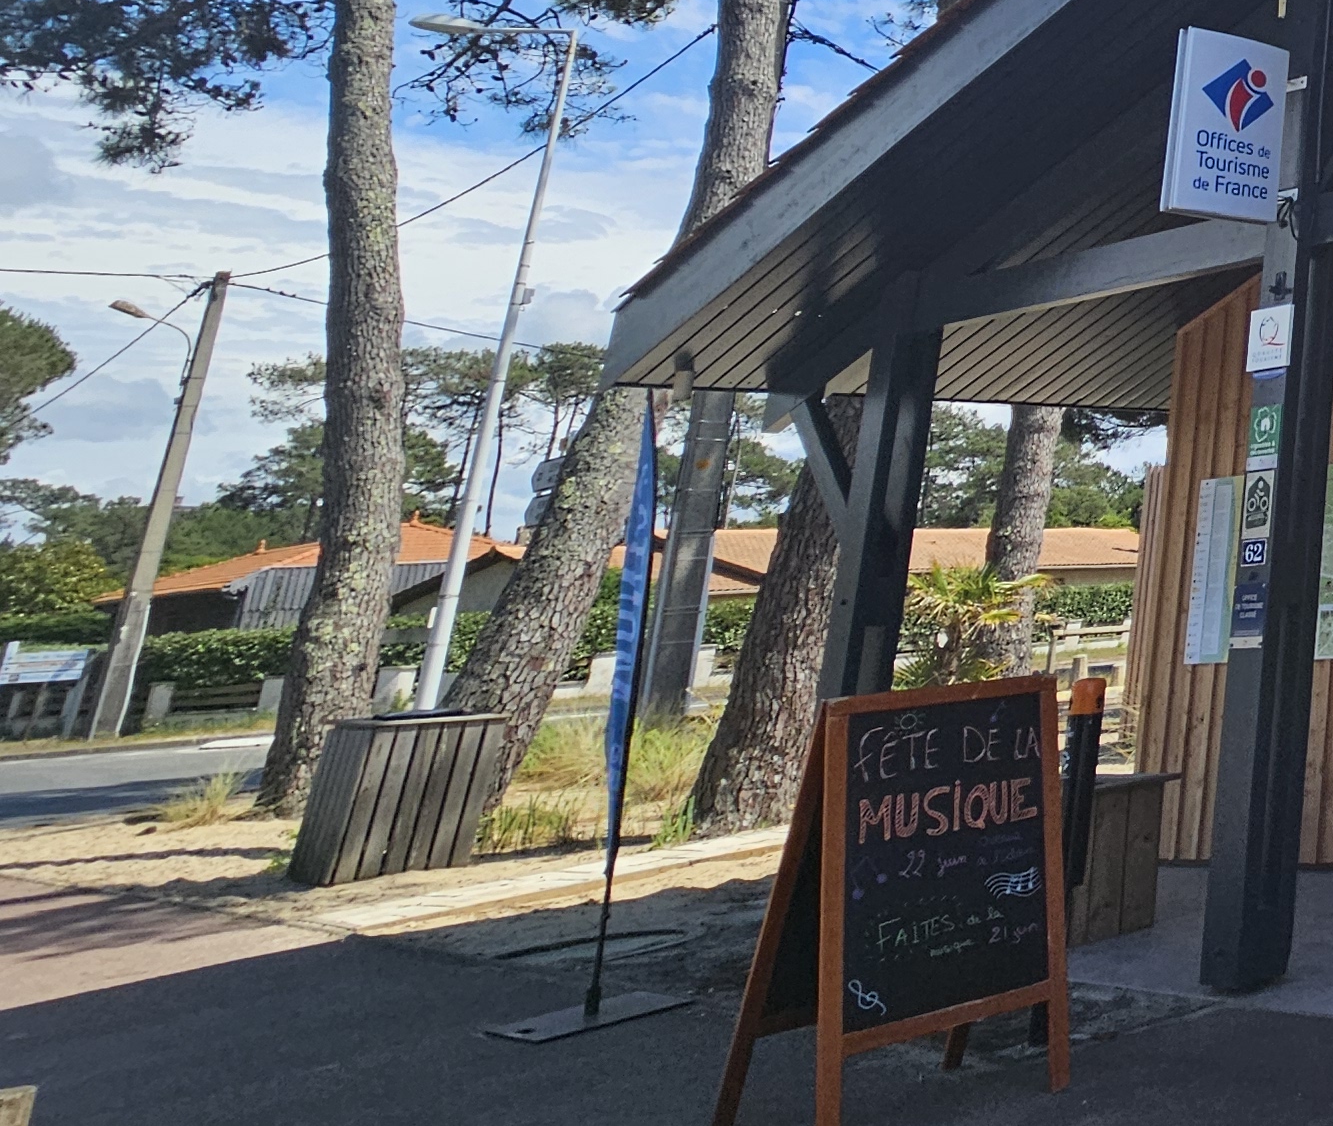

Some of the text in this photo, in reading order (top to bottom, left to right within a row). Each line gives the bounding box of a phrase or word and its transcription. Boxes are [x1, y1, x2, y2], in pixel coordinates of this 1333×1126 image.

[1196, 129, 1271, 159] Offices de
[1196, 150, 1270, 179] Tourisme
[1192, 175, 1268, 200] de France
[1244, 543, 1262, 562] 62
[854, 726, 939, 782] FÊTE
[963, 725, 1000, 762] DE
[1013, 727, 1041, 761] LA
[858, 777, 1038, 845] MUSIQUE
[876, 914, 955, 952] FAITES
[988, 926, 1008, 944] 21
